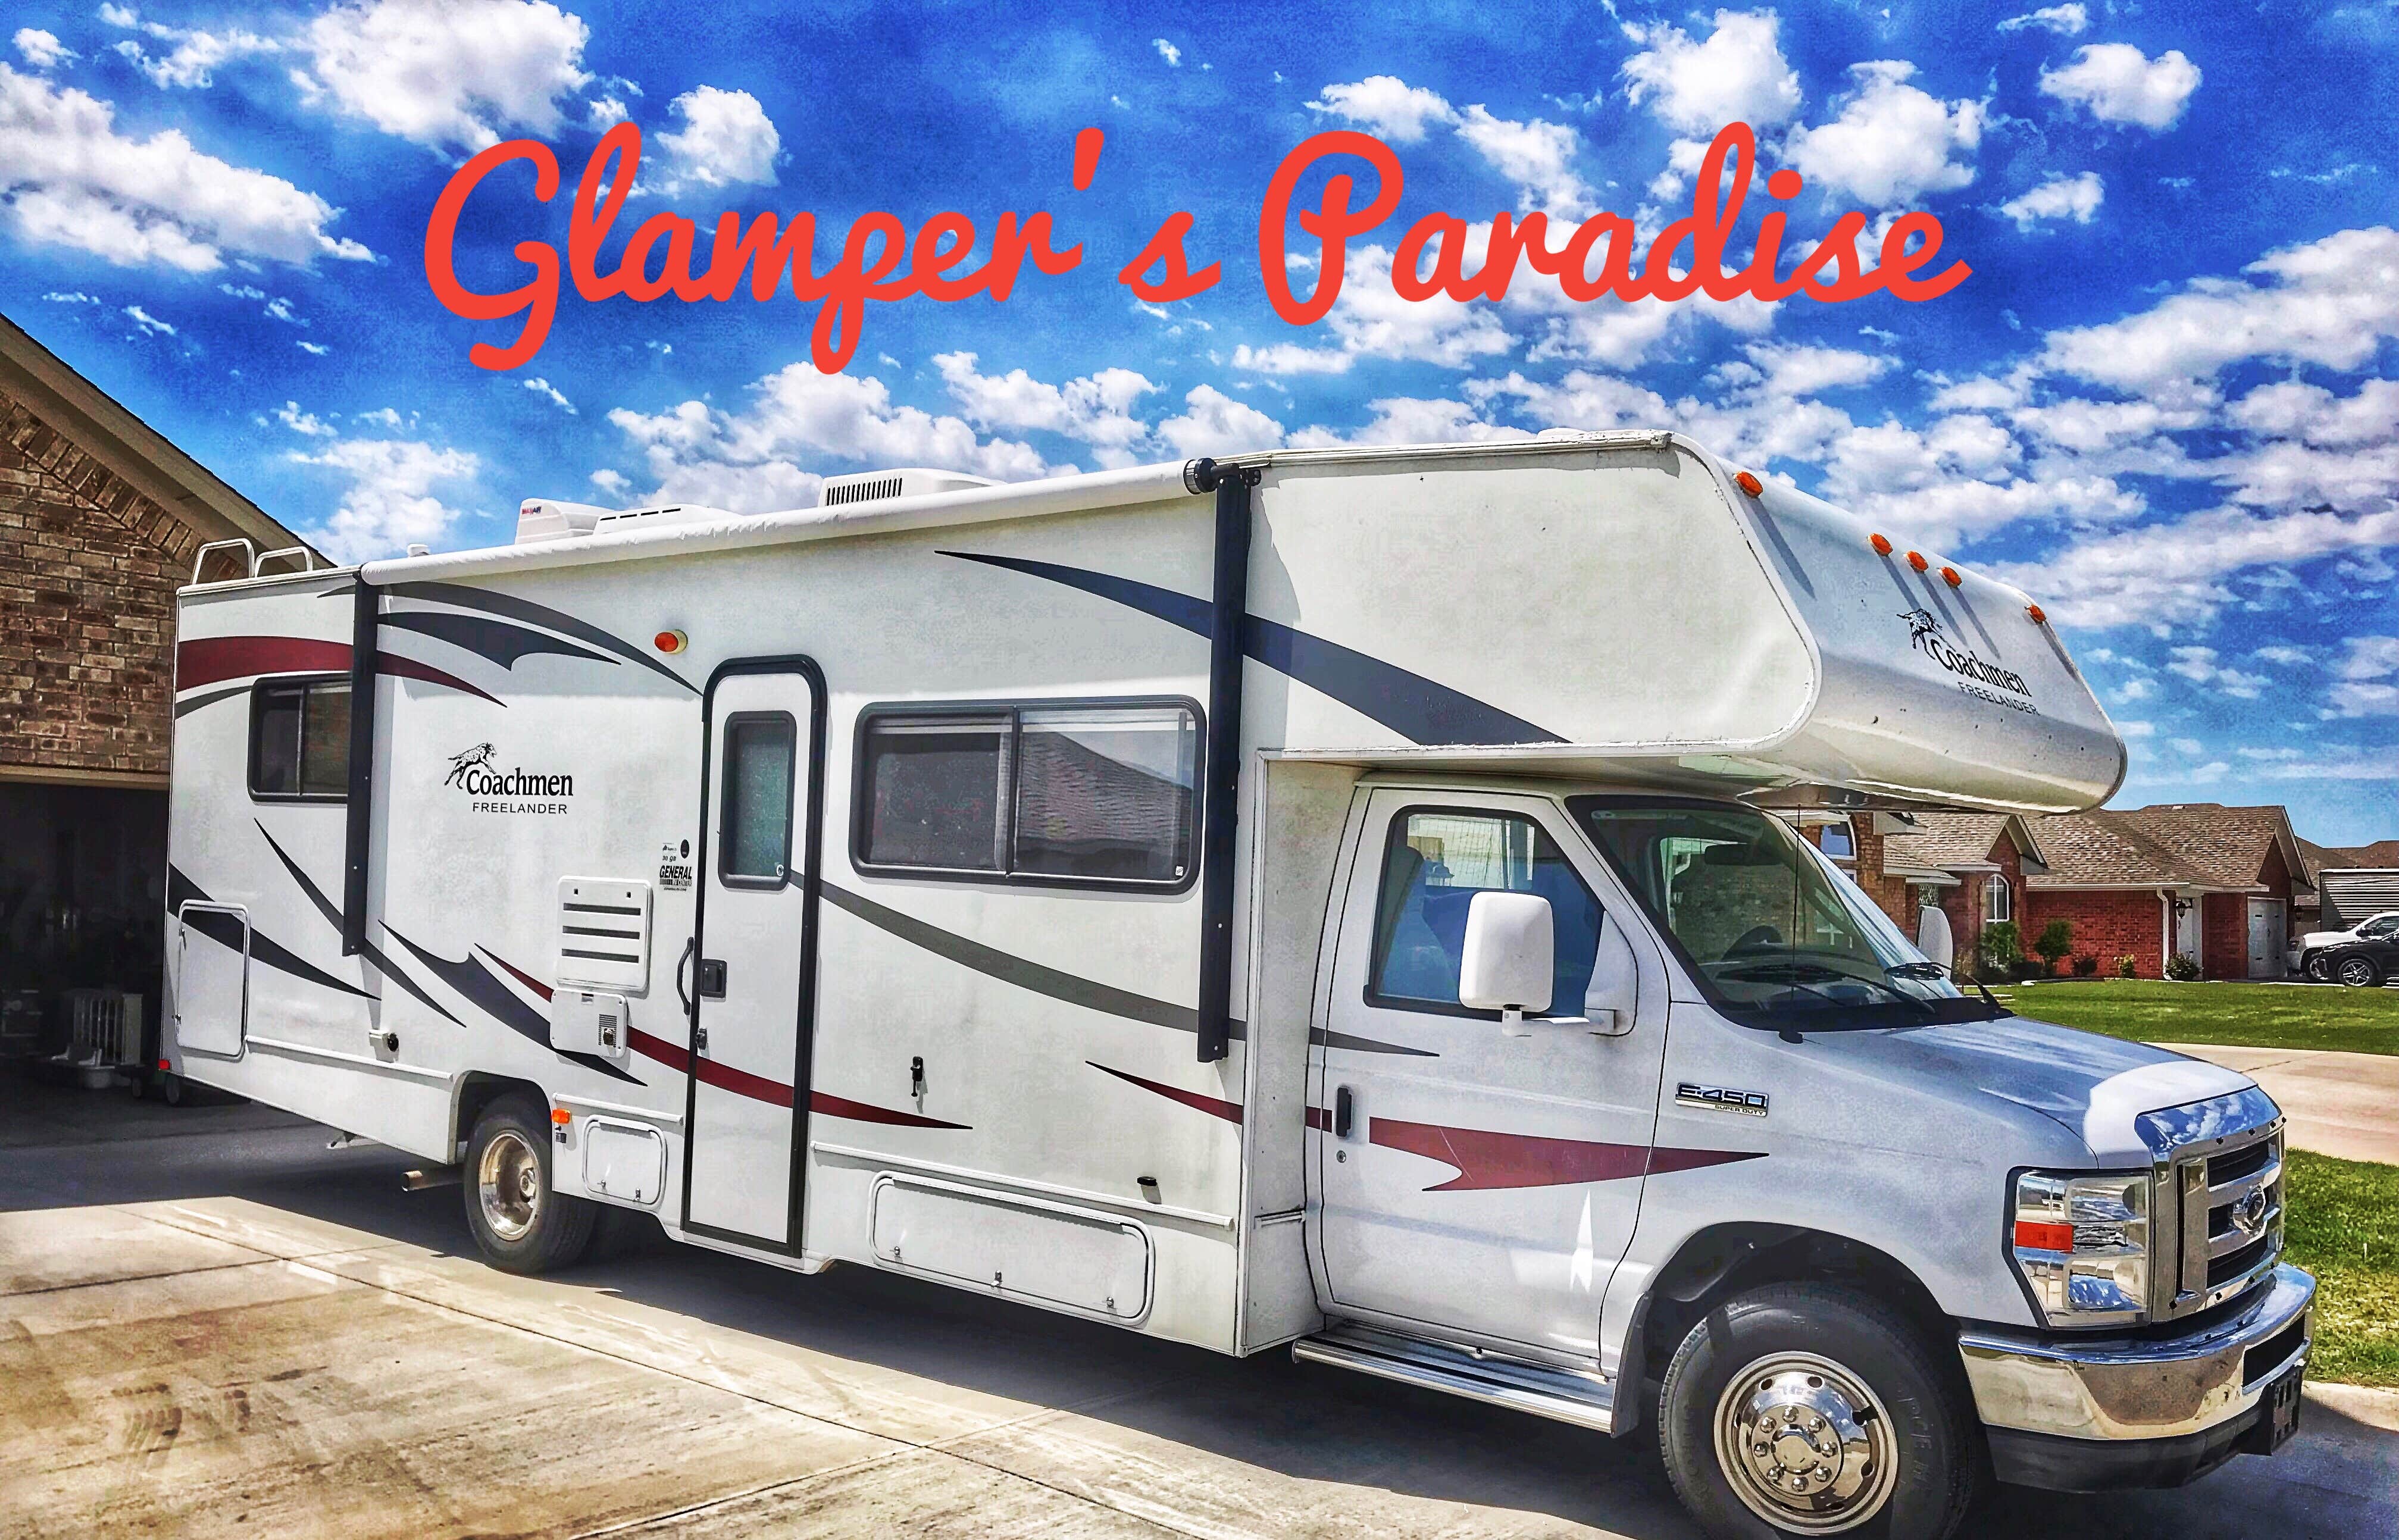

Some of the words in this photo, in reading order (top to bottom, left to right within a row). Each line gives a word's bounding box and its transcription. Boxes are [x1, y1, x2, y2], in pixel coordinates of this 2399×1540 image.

[1930, 638, 2032, 697] Coachmen
[1957, 681, 2040, 716] FREELANDER
[466, 766, 574, 796] Coachmen
[473, 802, 567, 814] FREELANDER
[659, 865, 692, 879] GENERAL
[1677, 1084, 1766, 1107] E-450
[1715, 1104, 1741, 1113] SUPER
